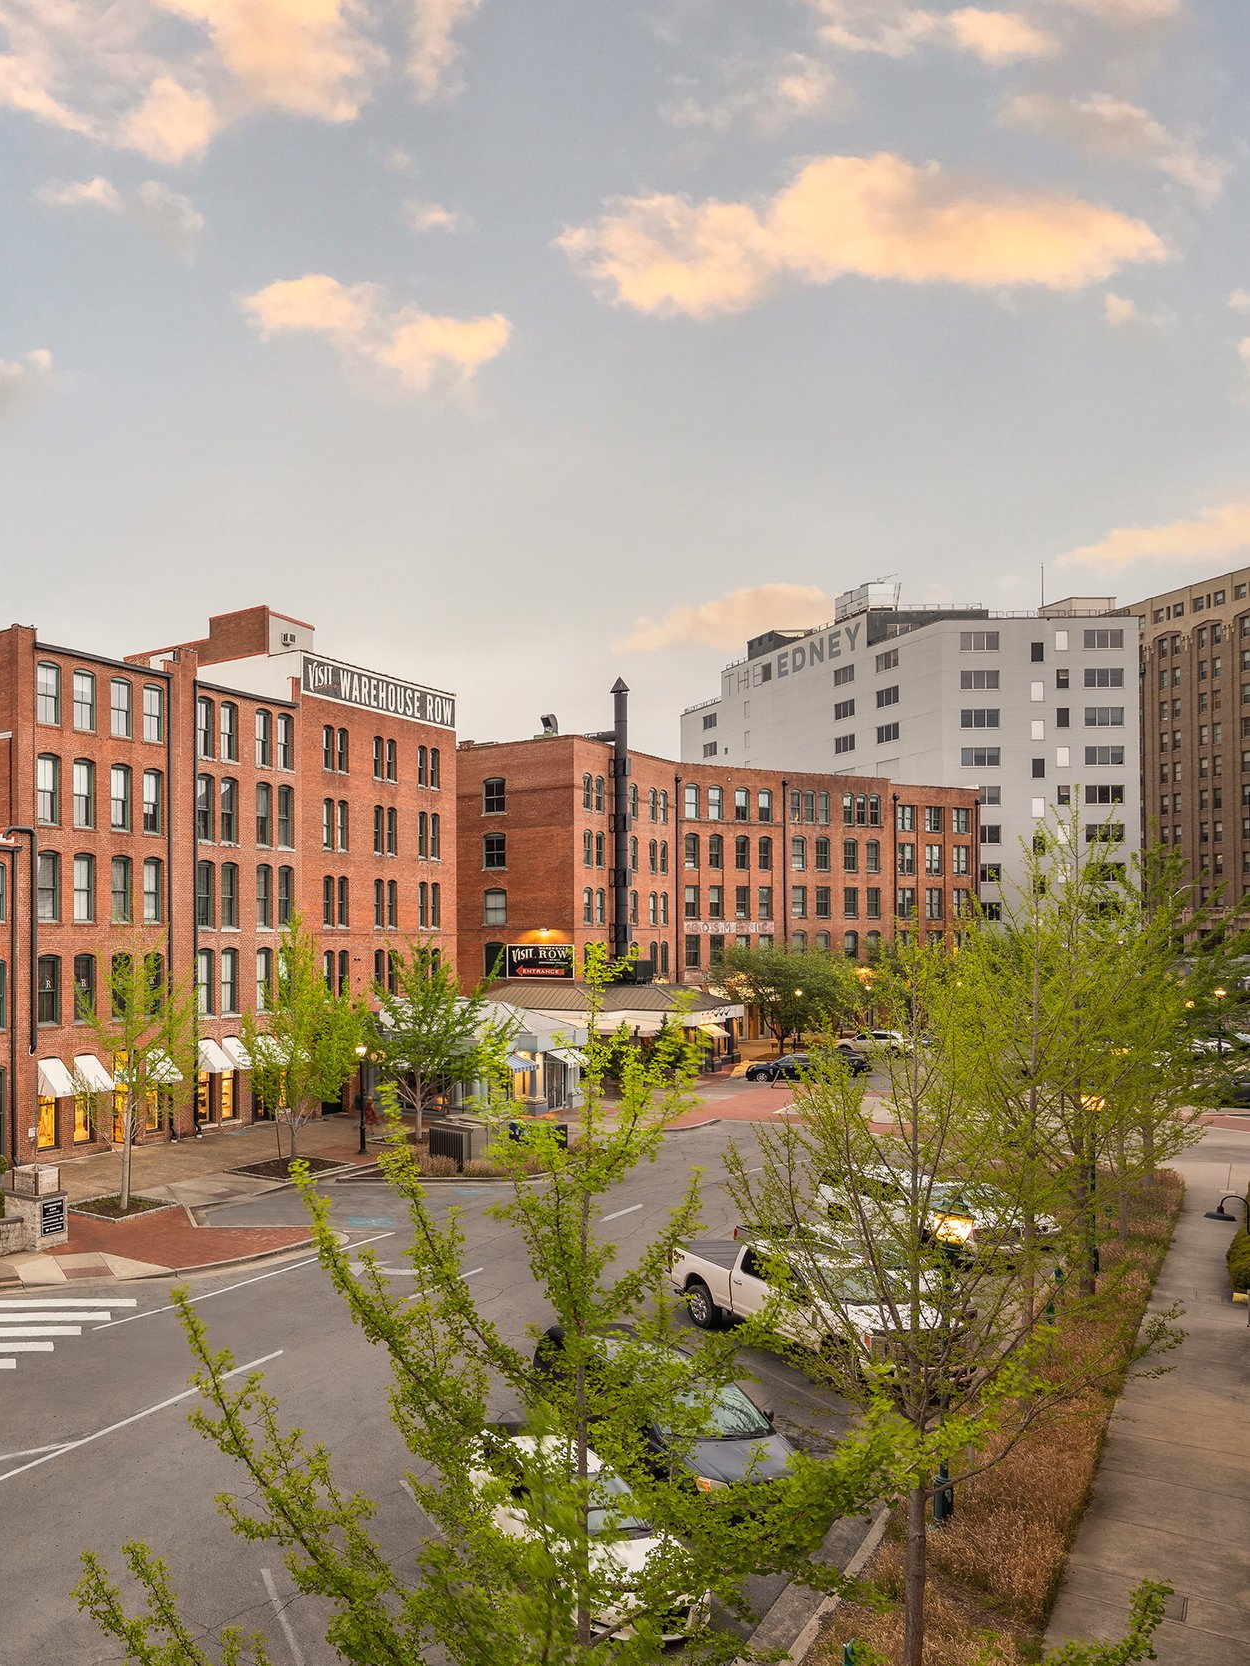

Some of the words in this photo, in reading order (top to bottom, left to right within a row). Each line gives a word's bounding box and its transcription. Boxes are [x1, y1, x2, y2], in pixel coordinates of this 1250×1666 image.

[777, 622, 862, 679] EDNEY
[308, 661, 333, 692] VISIT
[339, 669, 421, 719] WAREHOUSE
[426, 696, 453, 726] ROW
[512, 948, 533, 962] VISIT
[538, 950, 567, 958] ROW
[45, 980, 52, 989] R
[81, 979, 87, 987] R
